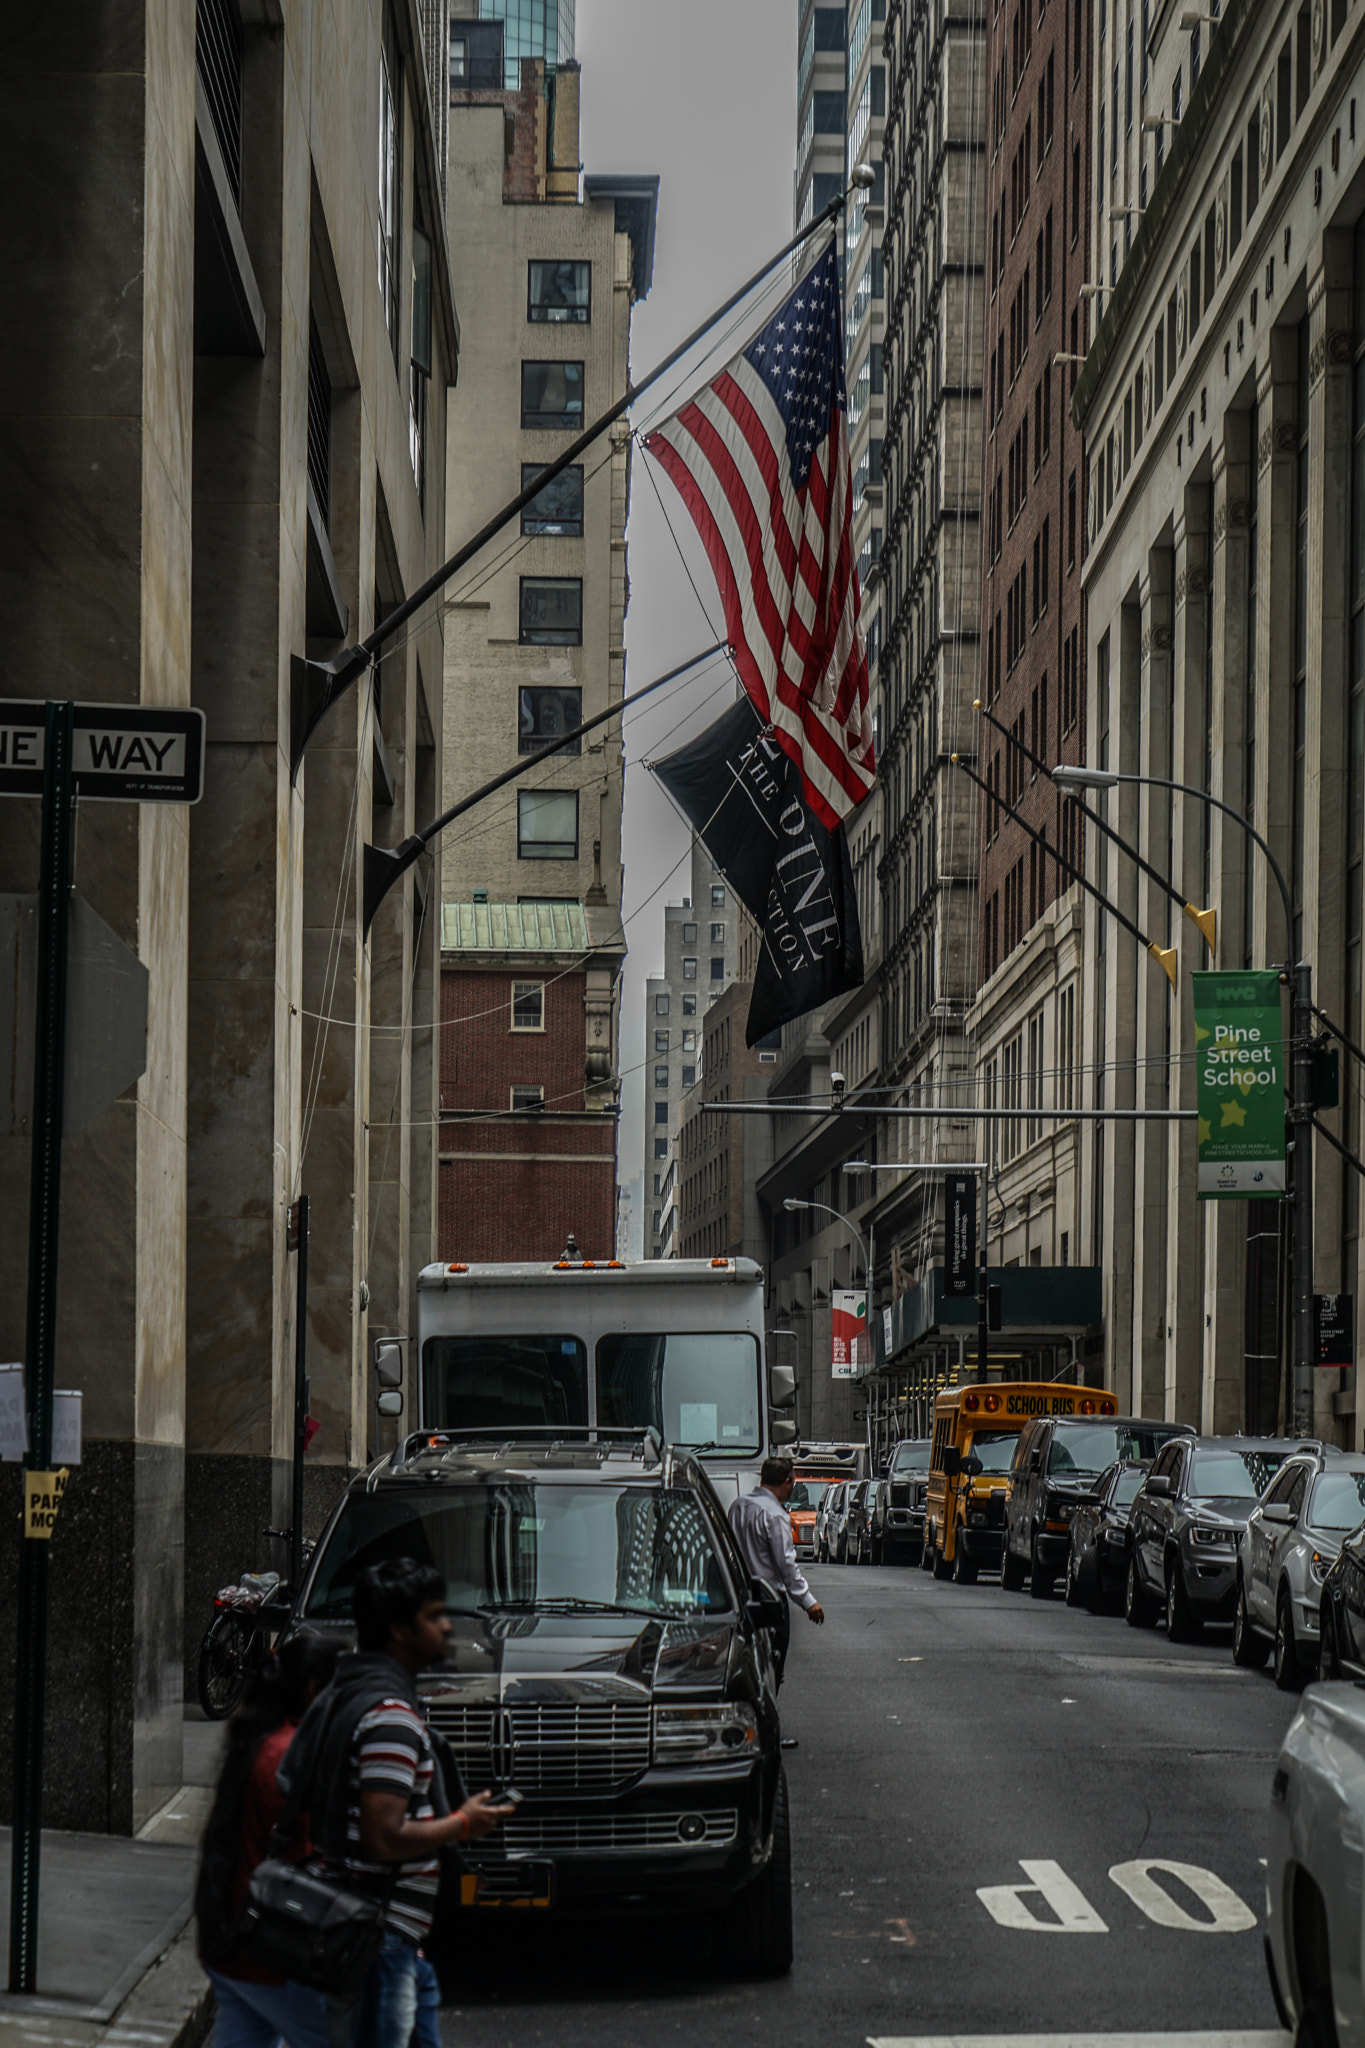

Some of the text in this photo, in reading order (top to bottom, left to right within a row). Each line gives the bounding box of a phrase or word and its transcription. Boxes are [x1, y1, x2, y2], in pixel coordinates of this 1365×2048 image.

[89, 735, 176, 772] WAY
[738, 742, 779, 802] THE
[1216, 987, 1257, 1001] NYC
[1214, 1024, 1261, 1043] Pine
[1207, 1045, 1272, 1064] Street
[1203, 1066, 1277, 1086] School
[1008, 1396, 1073, 1415] SCHOOL BUS
